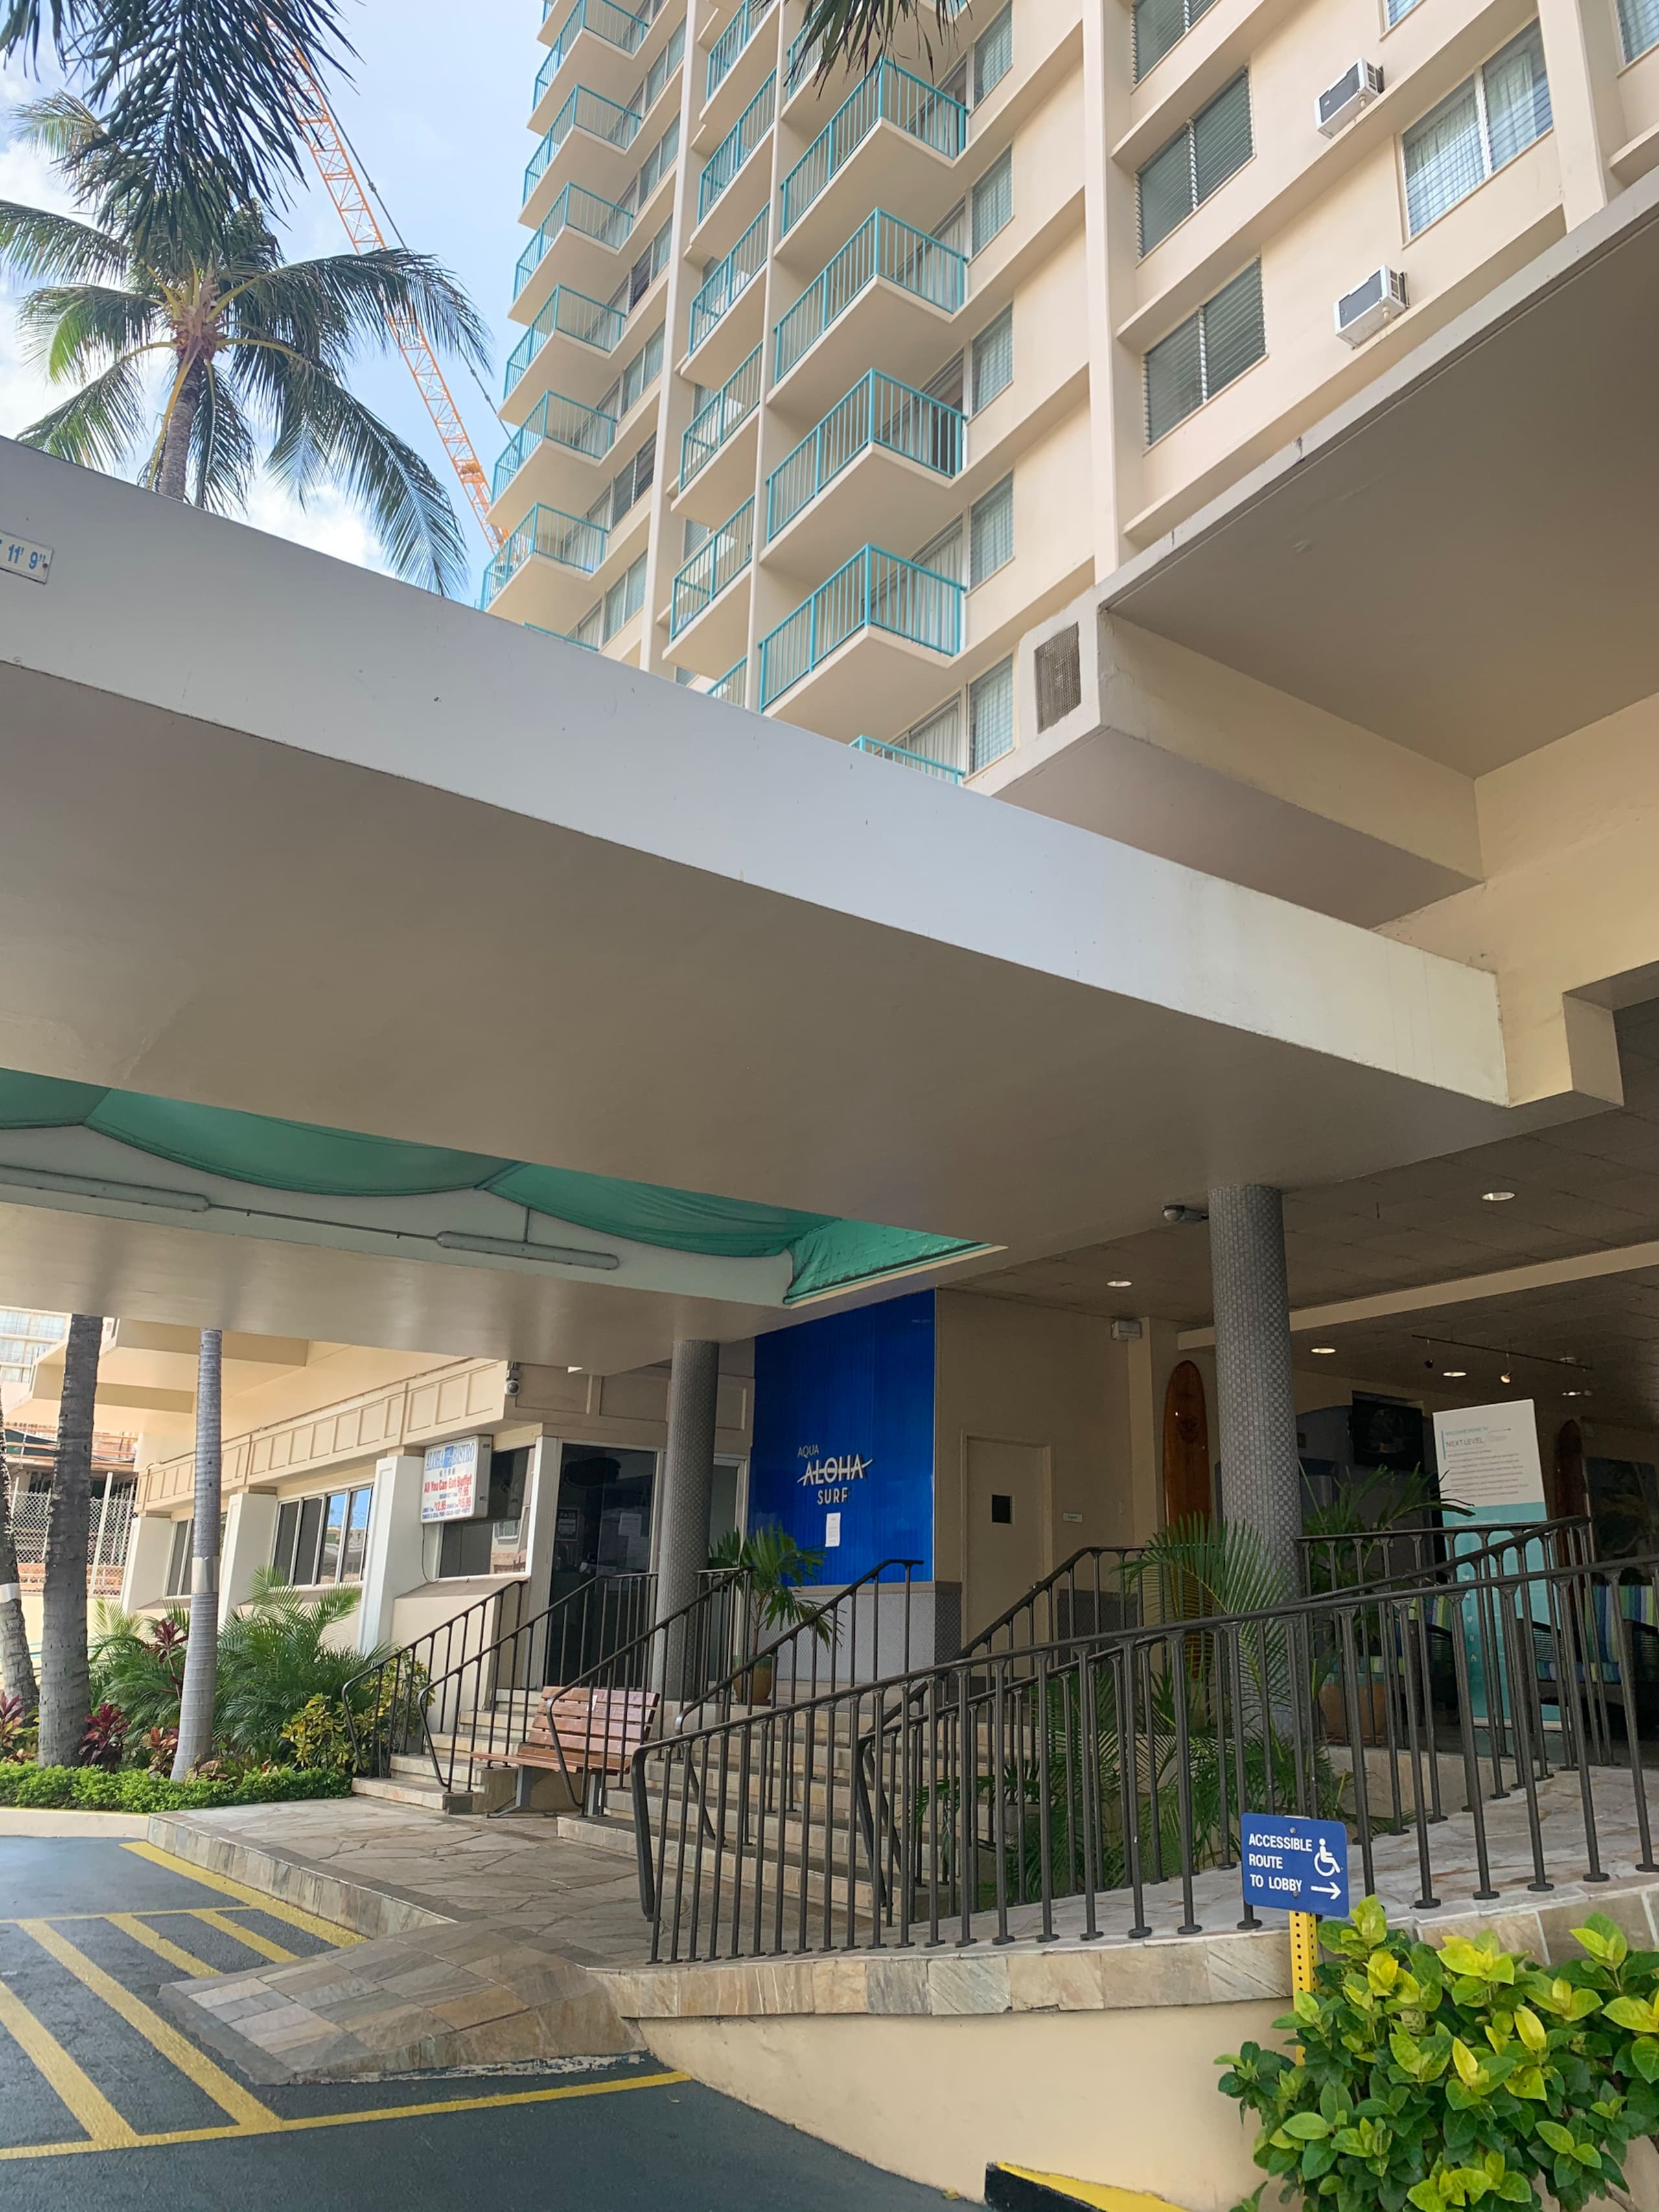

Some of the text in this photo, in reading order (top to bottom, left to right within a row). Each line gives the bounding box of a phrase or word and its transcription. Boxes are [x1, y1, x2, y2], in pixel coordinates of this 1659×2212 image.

[1465, 1437, 1483, 1445] LEVEL
[798, 1445, 819, 1458] AQUA
[797, 1454, 873, 1487] ALOHA
[817, 1487, 848, 1505] SURF
[1249, 1834, 1312, 1852] ACCESSIBLE
[1249, 1854, 1283, 1869] ROUTE
[1249, 1874, 1302, 1892] TO LOBBY
